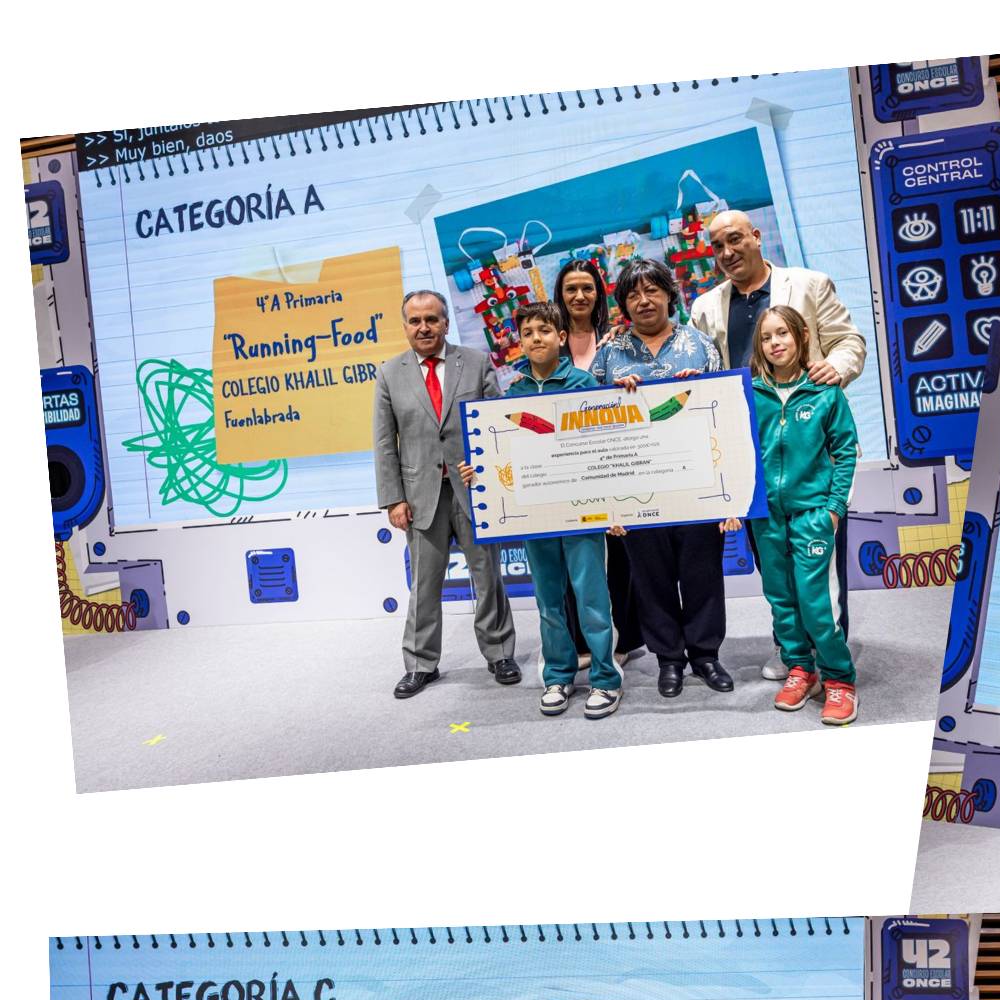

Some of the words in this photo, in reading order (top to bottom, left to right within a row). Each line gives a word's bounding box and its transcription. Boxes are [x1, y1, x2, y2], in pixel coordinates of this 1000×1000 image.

[896, 68, 930, 84] CONCURSO
[931, 64, 958, 78] ESCOLAR
[897, 75, 960, 94] ONCE
[115, 146, 147, 162] Muy
[152, 139, 190, 156] bien,
[196, 130, 234, 148] daos
[902, 157, 983, 177] CONTROL
[904, 171, 983, 188] CENTRAL
[27, 200, 51, 229] 2
[136, 183, 296, 239] CATEGORÍA
[303, 184, 325, 215] A
[960, 205, 996, 235] 11:11
[285, 290, 343, 310] Primaria
[222, 375, 280, 398] COLEGIO
[284, 367, 338, 391] KHALIL
[343, 361, 387, 385] GIBR
[43, 393, 79, 409] RTAS
[916, 391, 983, 413] IMAGINA
[224, 404, 301, 429] Fuenlabrada
[560, 404, 645, 431] INNOVA
[580, 472, 609, 481] Comunidad
[587, 463, 610, 471] COLEGIO
[901, 938, 951, 969] 42
[902, 978, 952, 988] ONCE
